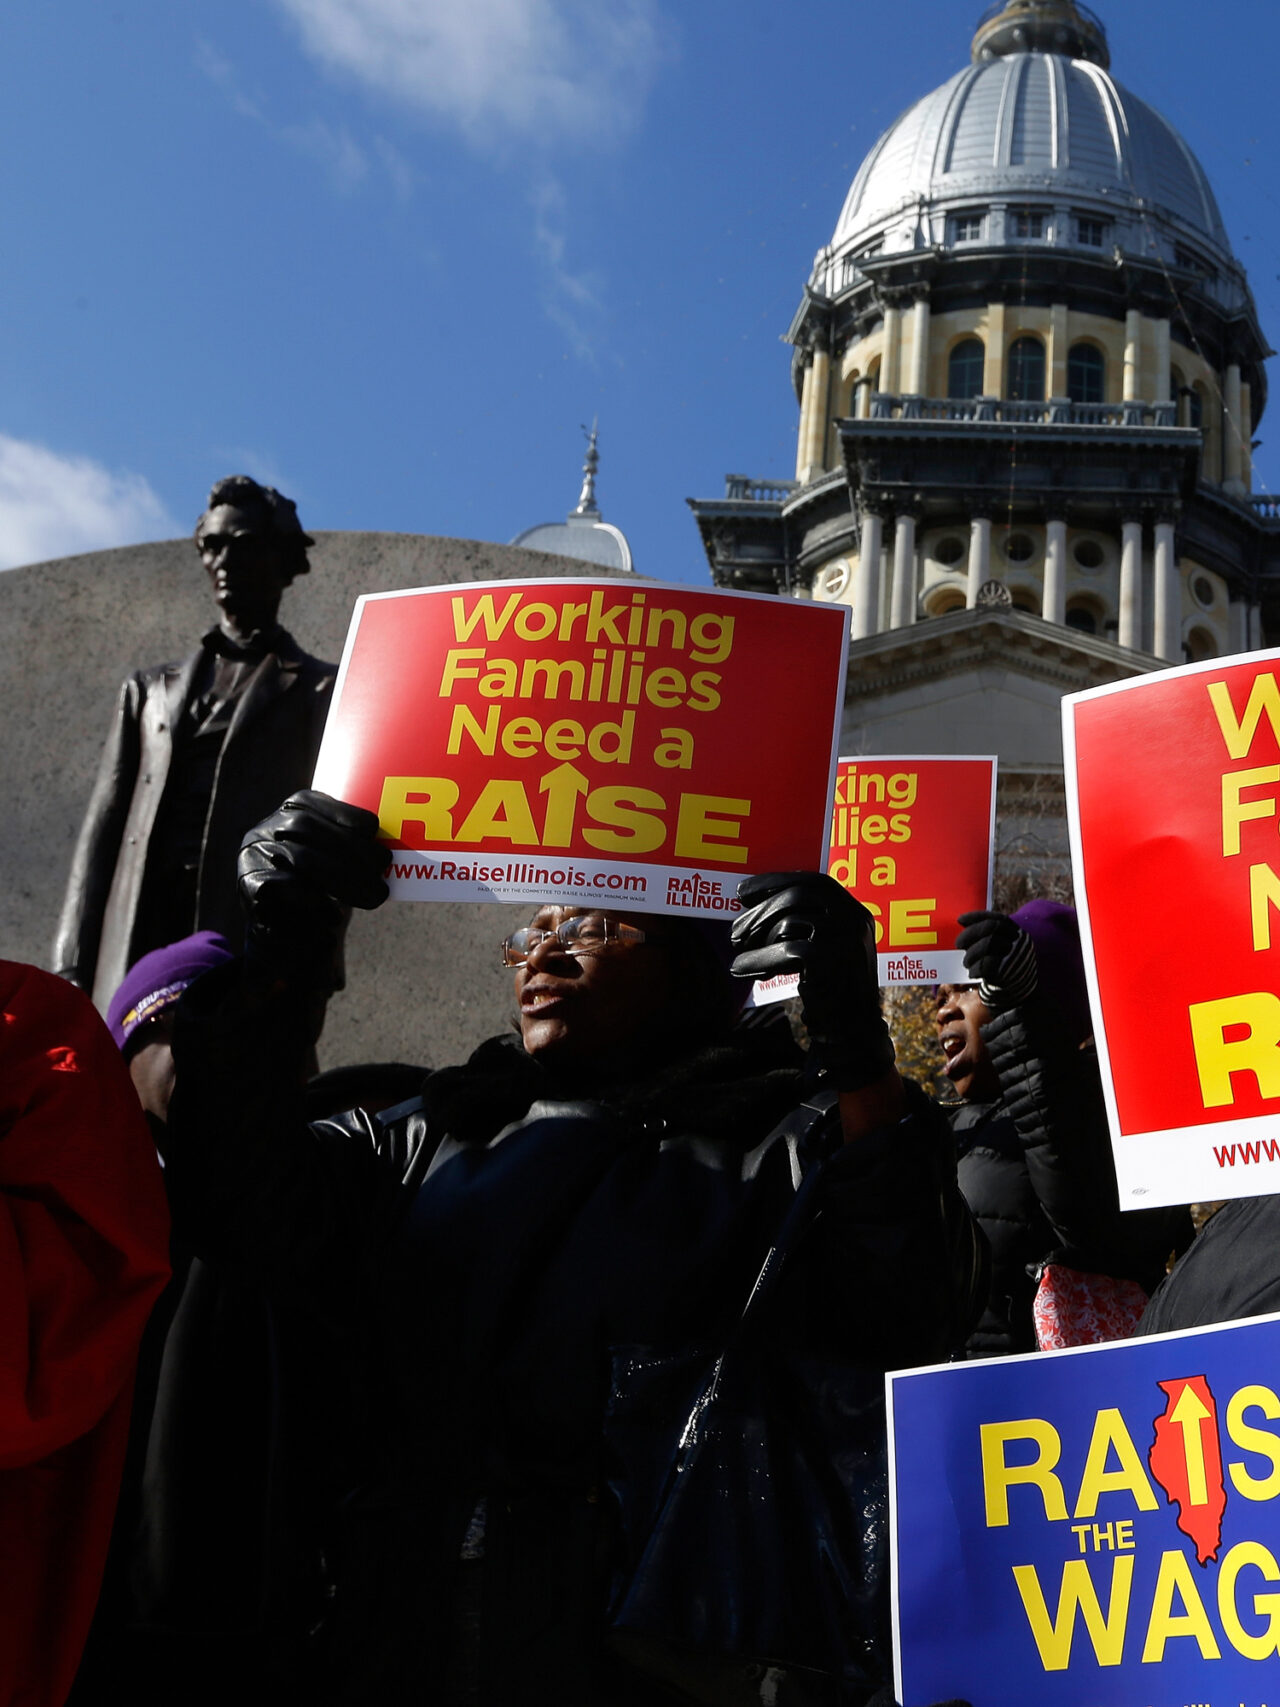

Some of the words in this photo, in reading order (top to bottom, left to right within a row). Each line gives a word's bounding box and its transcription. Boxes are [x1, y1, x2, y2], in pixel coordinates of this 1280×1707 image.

[453, 591, 735, 663] Working
[439, 648, 722, 716] Families
[447, 704, 636, 765] Need
[654, 728, 694, 769] a
[377, 762, 751, 864] RAISE
[668, 872, 722, 896] RAISE
[870, 856, 896, 886] a
[666, 892, 742, 912] ILLINOIS
[888, 955, 923, 971] RAISE
[888, 969, 938, 981] ILLINOIS
[1071, 1520, 1136, 1554] THE
